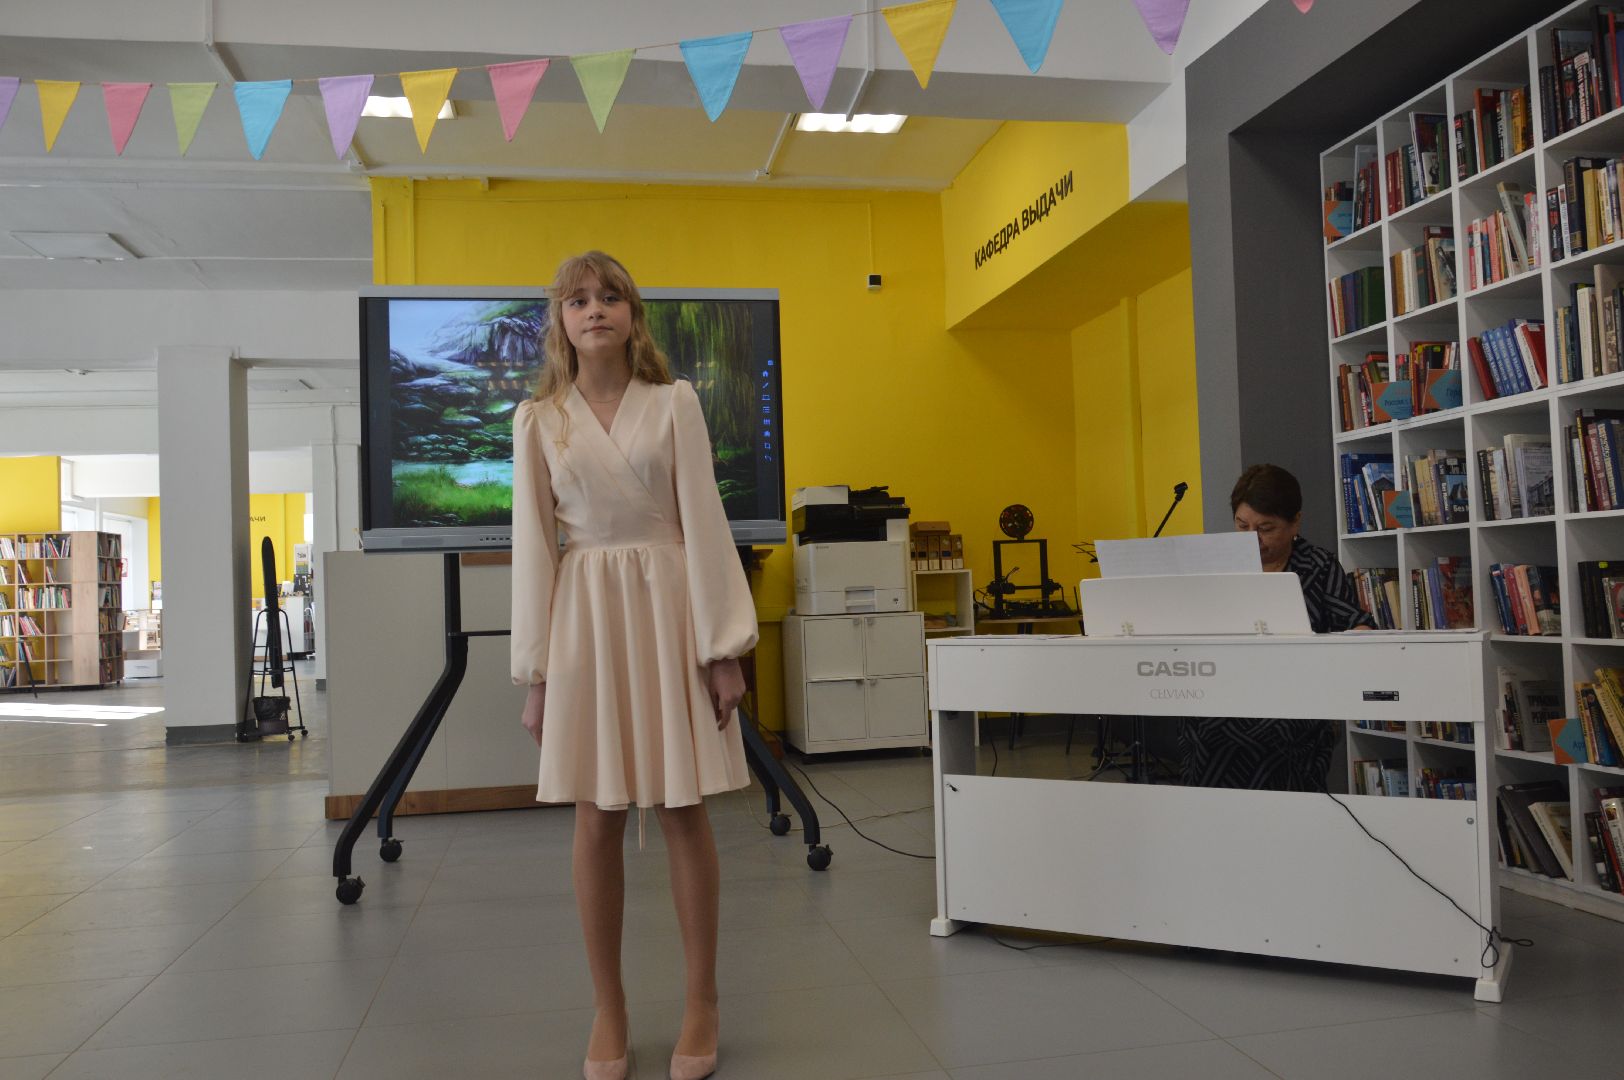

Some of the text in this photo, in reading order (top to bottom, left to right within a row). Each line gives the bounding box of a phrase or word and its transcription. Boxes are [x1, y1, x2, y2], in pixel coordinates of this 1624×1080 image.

[974, 170, 1073, 270] КАФЕДРА ВЫДАЧИ
[1137, 661, 1216, 676] CASIO
[1150, 688, 1205, 699] CELVIANO
